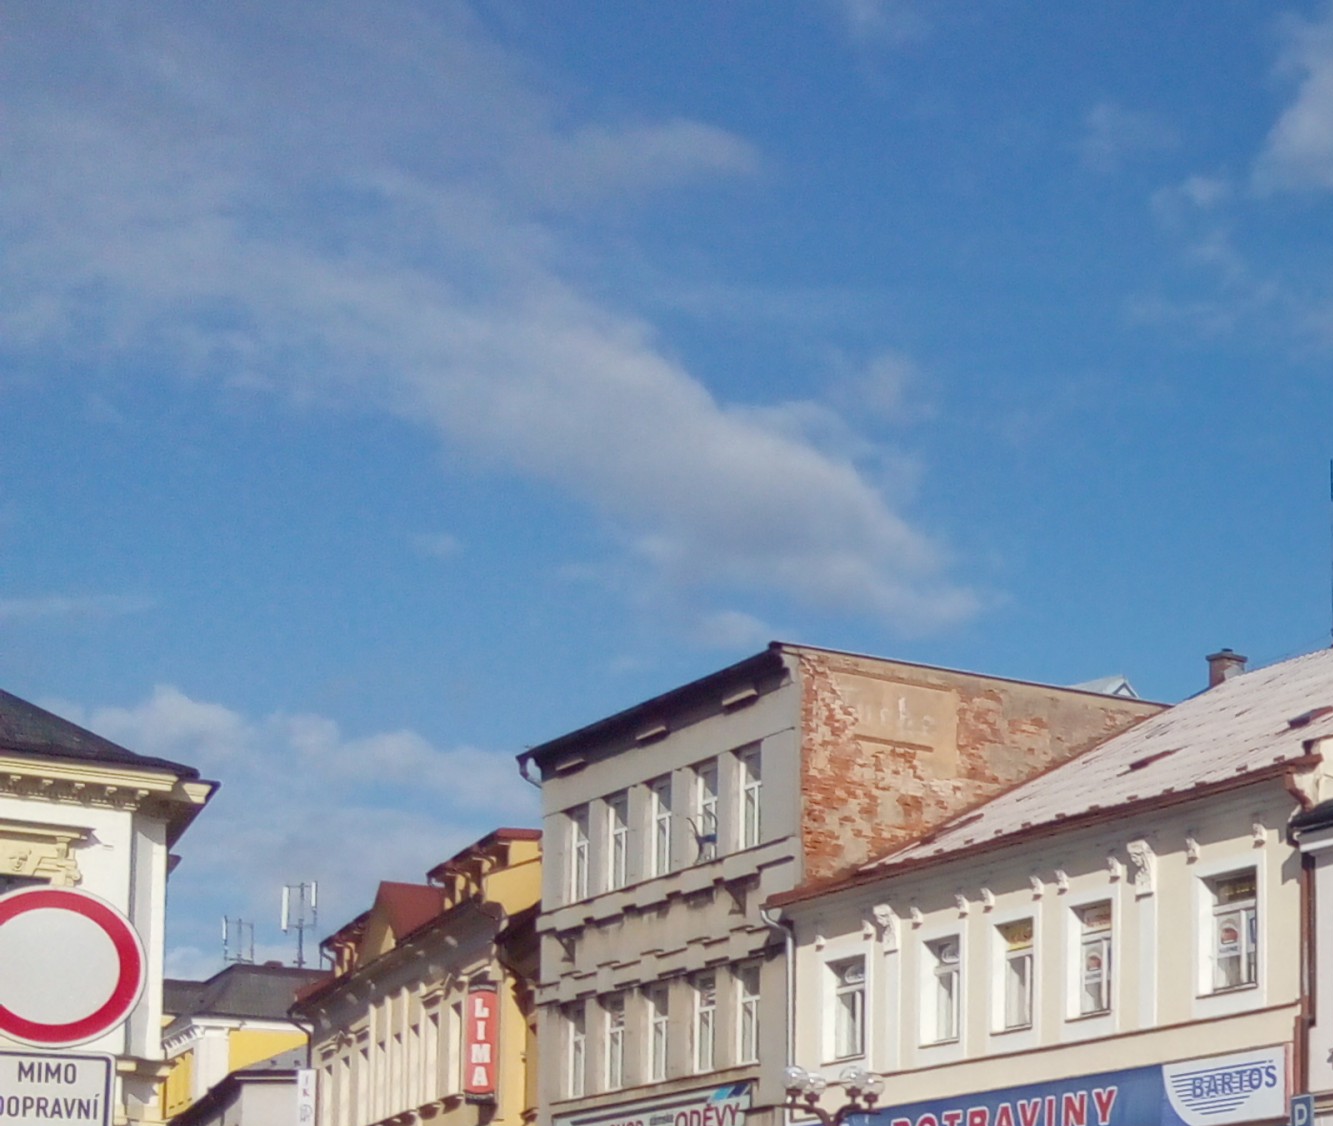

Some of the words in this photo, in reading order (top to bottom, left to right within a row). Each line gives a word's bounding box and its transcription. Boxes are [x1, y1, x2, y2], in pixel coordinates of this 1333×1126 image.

[471, 998, 491, 1086] LIMA
[17, 1061, 76, 1084] MIMO
[1191, 1061, 1277, 1099] BARTOŠ
